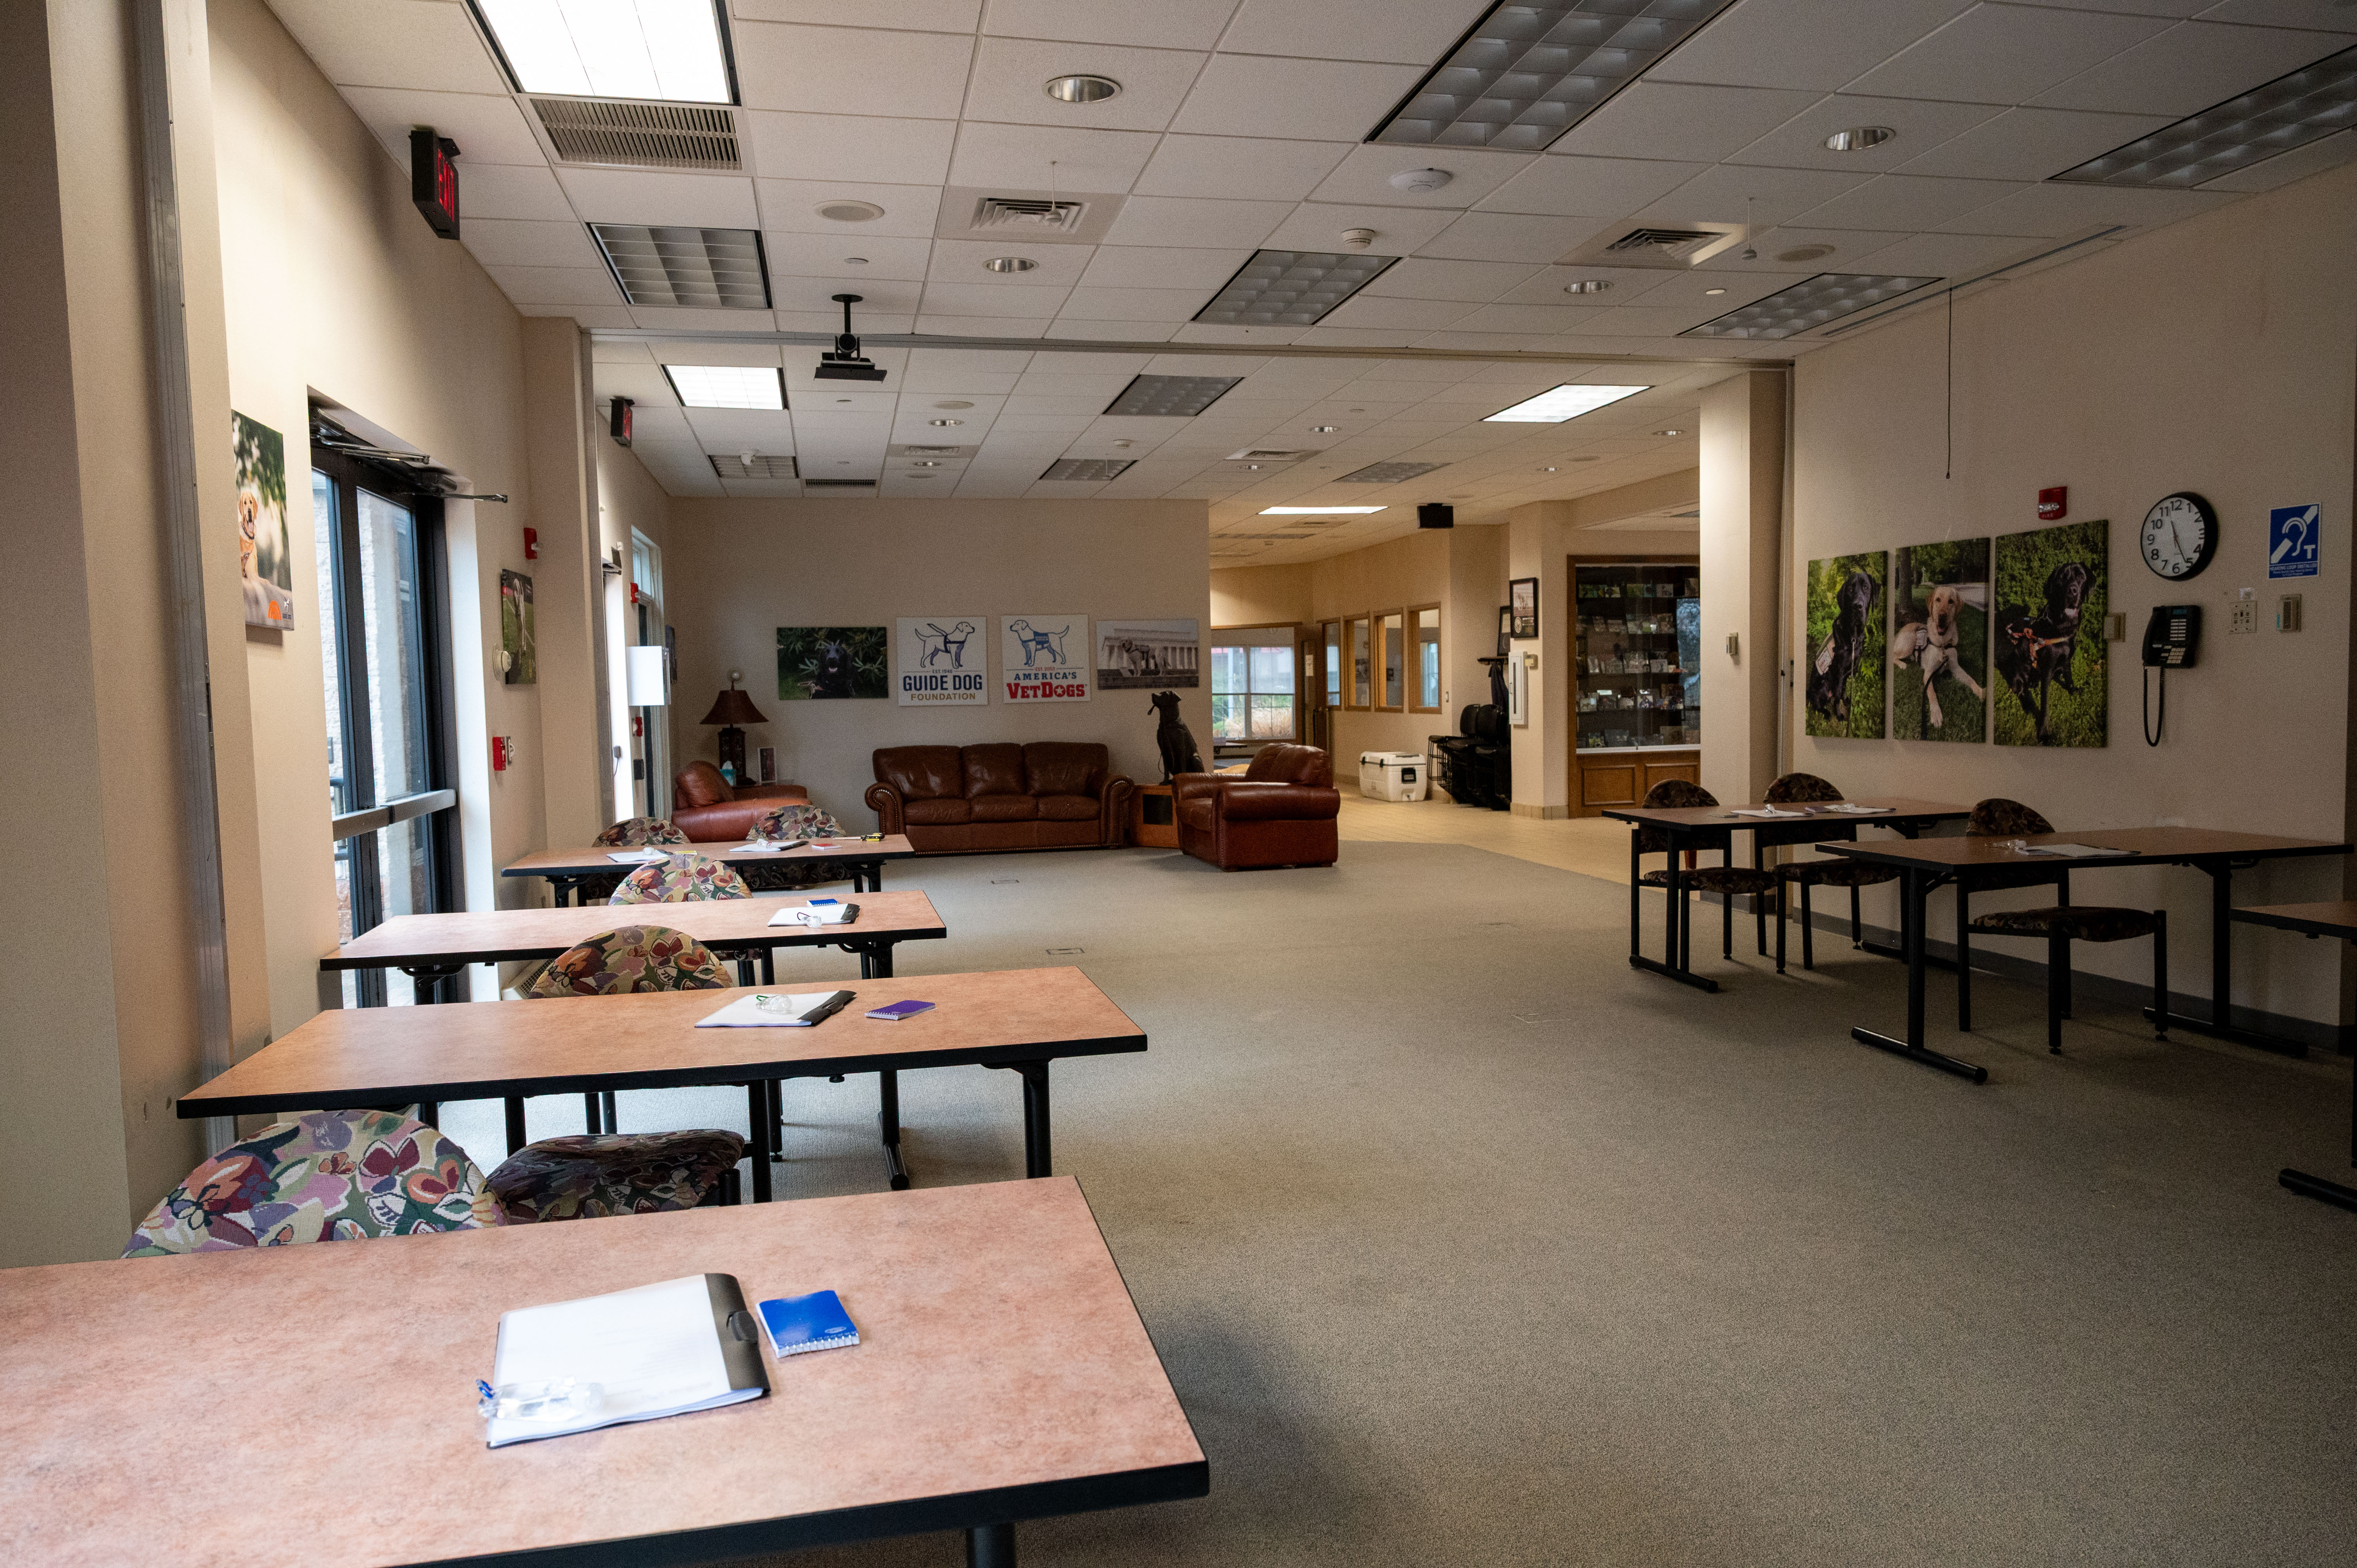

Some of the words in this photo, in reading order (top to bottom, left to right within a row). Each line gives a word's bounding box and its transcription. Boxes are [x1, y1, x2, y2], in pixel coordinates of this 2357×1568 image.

[2170, 500, 2182, 511] 12
[2186, 503, 2191, 513] 1
[2159, 506, 2169, 517] 11
[2194, 511, 2202, 523] 2
[2151, 519, 2163, 530] 10
[2147, 534, 2154, 545] 9
[2198, 528, 2205, 540] 3
[2193, 544, 2202, 553] 4
[2304, 544, 2315, 559] T
[2151, 549, 2159, 560] 8
[2161, 560, 2168, 570] 7
[2172, 563, 2180, 574] 6
[2186, 558, 2193, 568] 5
[1014, 672, 1077, 680] AMERICA'S
[903, 675, 948, 691] GUIDE
[953, 675, 982, 690] DOG
